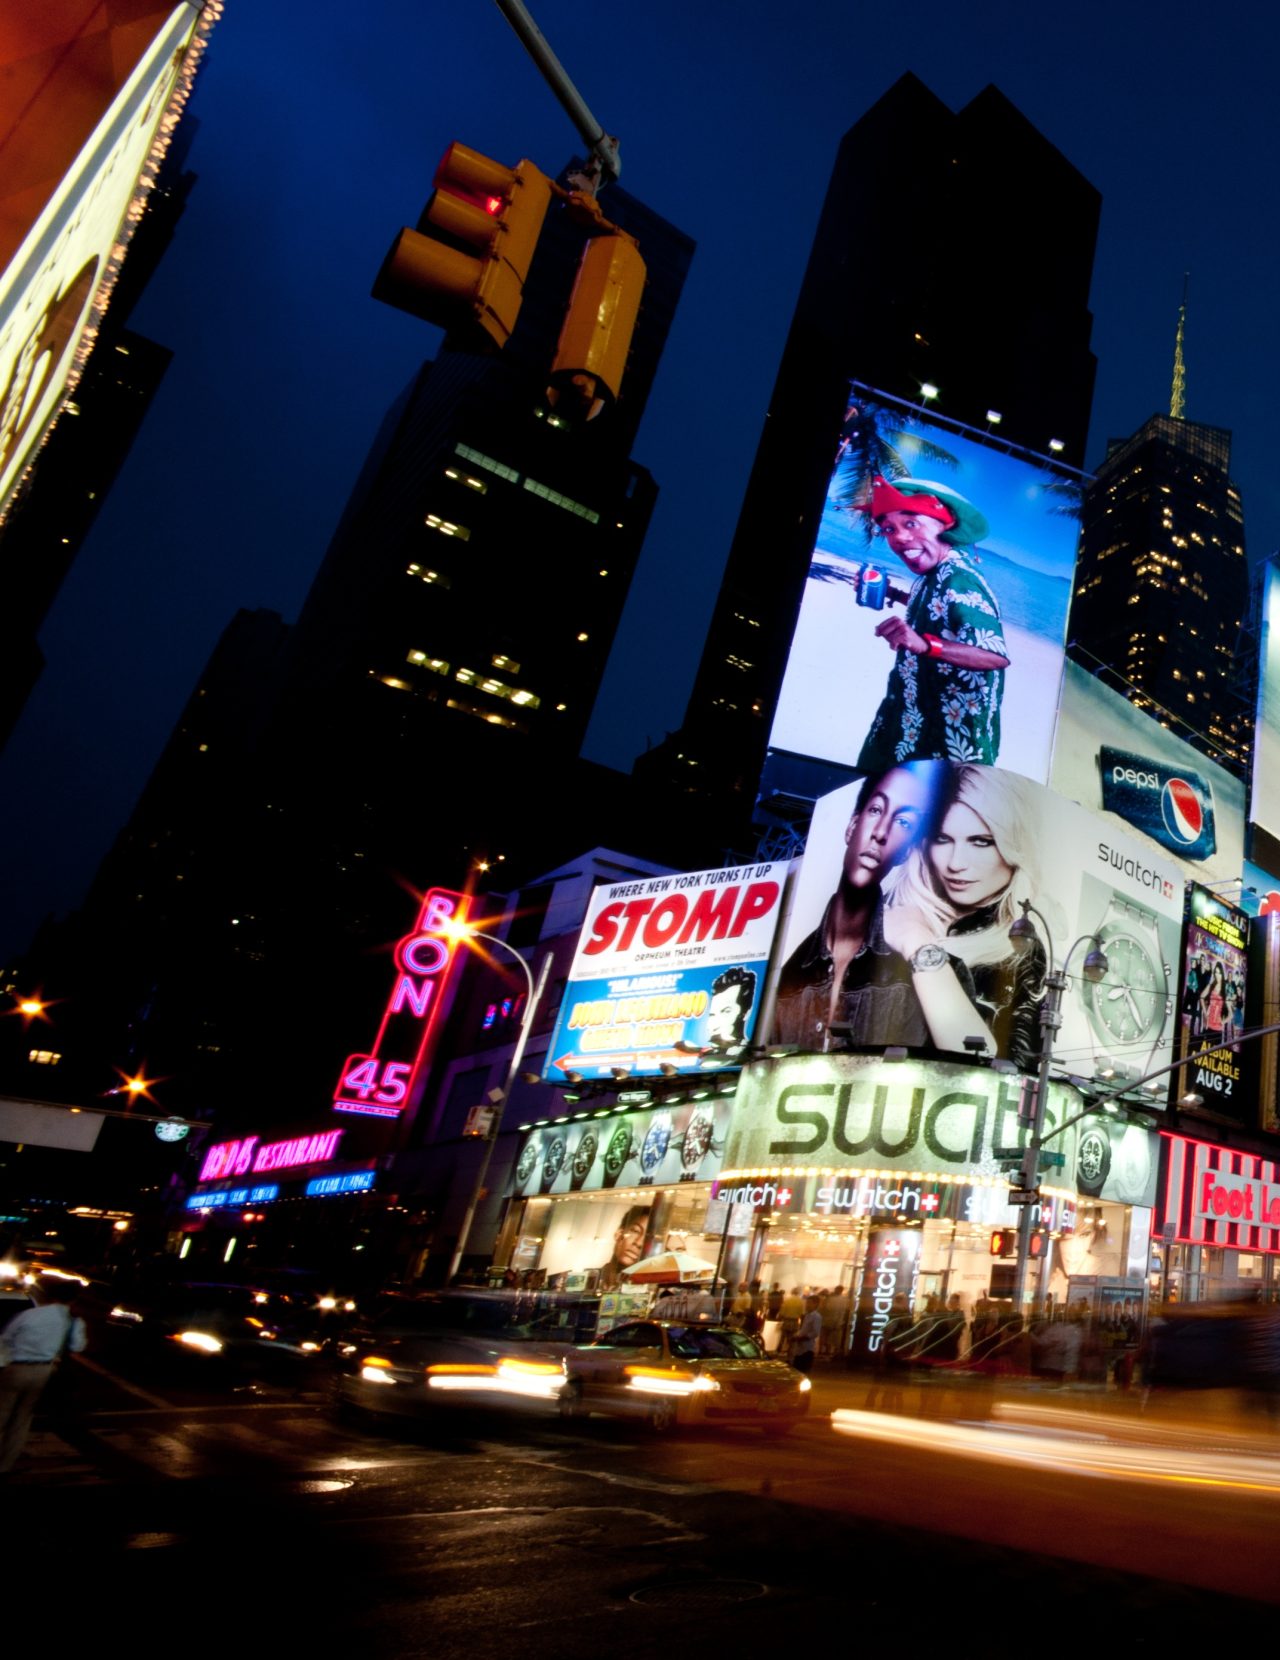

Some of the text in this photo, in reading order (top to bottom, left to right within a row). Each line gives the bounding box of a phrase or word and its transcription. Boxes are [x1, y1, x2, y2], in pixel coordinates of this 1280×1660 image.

[1112, 765, 1159, 789] pepsi
[609, 864, 772, 899] WHERE NEW YORK TURNS IT UP
[1098, 843, 1164, 893] swatch
[583, 880, 780, 956] STOMP
[635, 946, 706, 962] ORPHEUM THEATRE
[1191, 1050, 1240, 1081] AVAILABLE
[1201, 1040, 1233, 1064] ALBUM
[344, 1058, 413, 1104] 45
[1195, 1072, 1233, 1095] AUG 2
[252, 1128, 345, 1173] RESTAURANT
[815, 1188, 921, 1213] swatch
[1202, 1171, 1253, 1218] Foot
[868, 1257, 900, 1352] swatch
